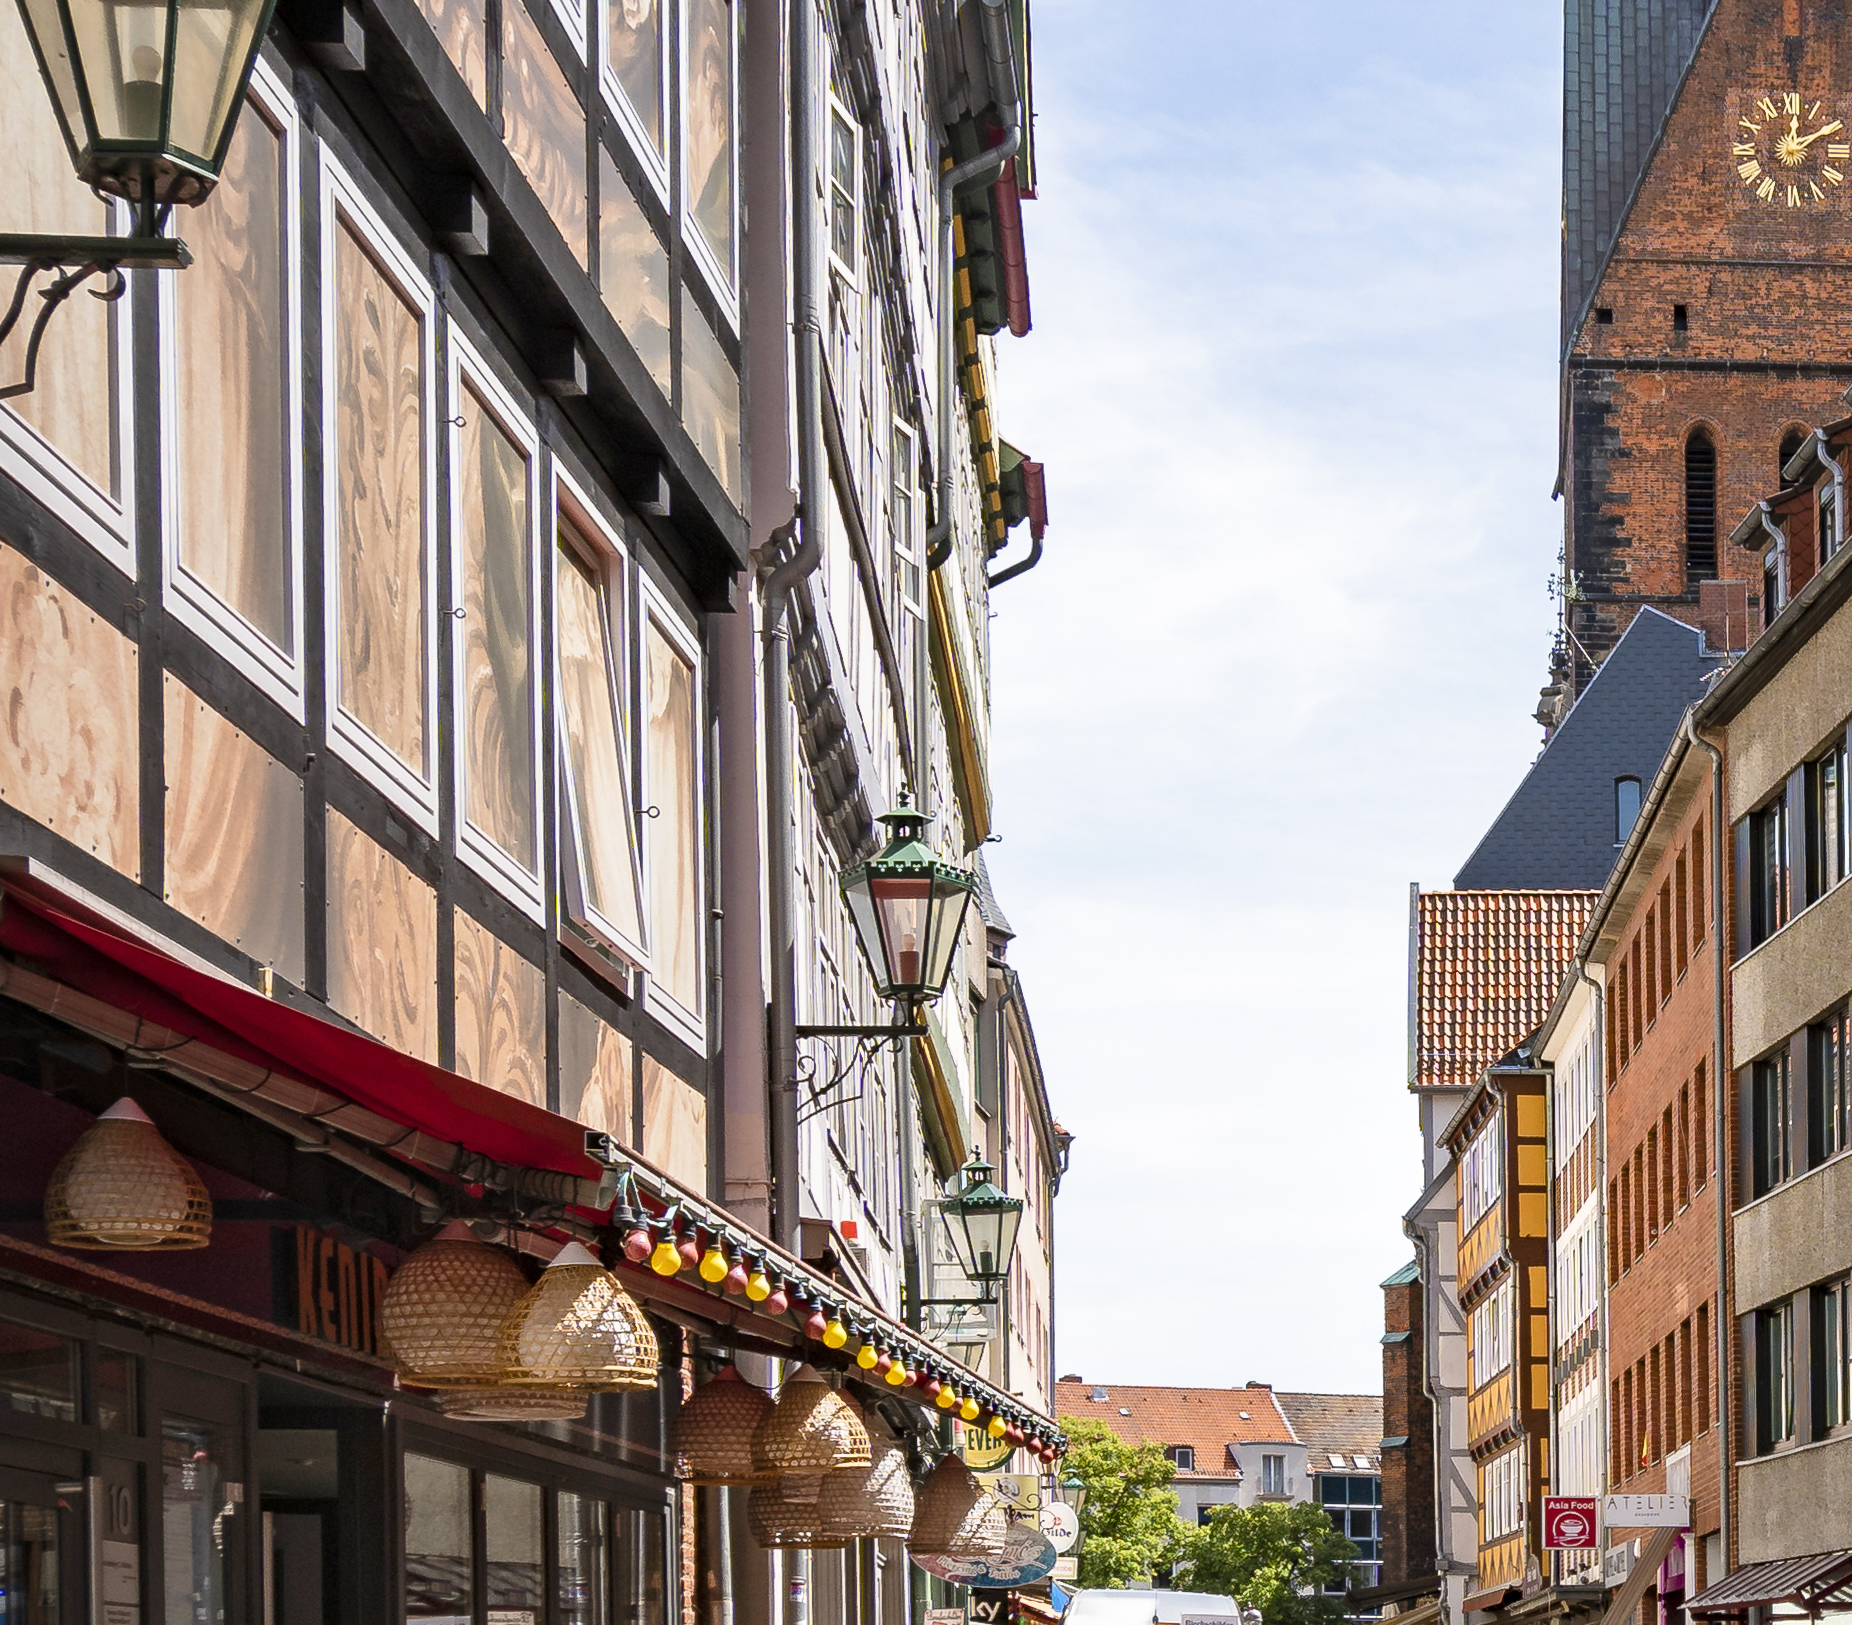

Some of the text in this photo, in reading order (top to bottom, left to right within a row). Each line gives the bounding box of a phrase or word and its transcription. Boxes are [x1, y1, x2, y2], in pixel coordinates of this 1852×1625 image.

[110, 1485, 132, 1535] 10
[1548, 1501, 1594, 1510] Asia Food
[1607, 1496, 1688, 1510] ATELIER
